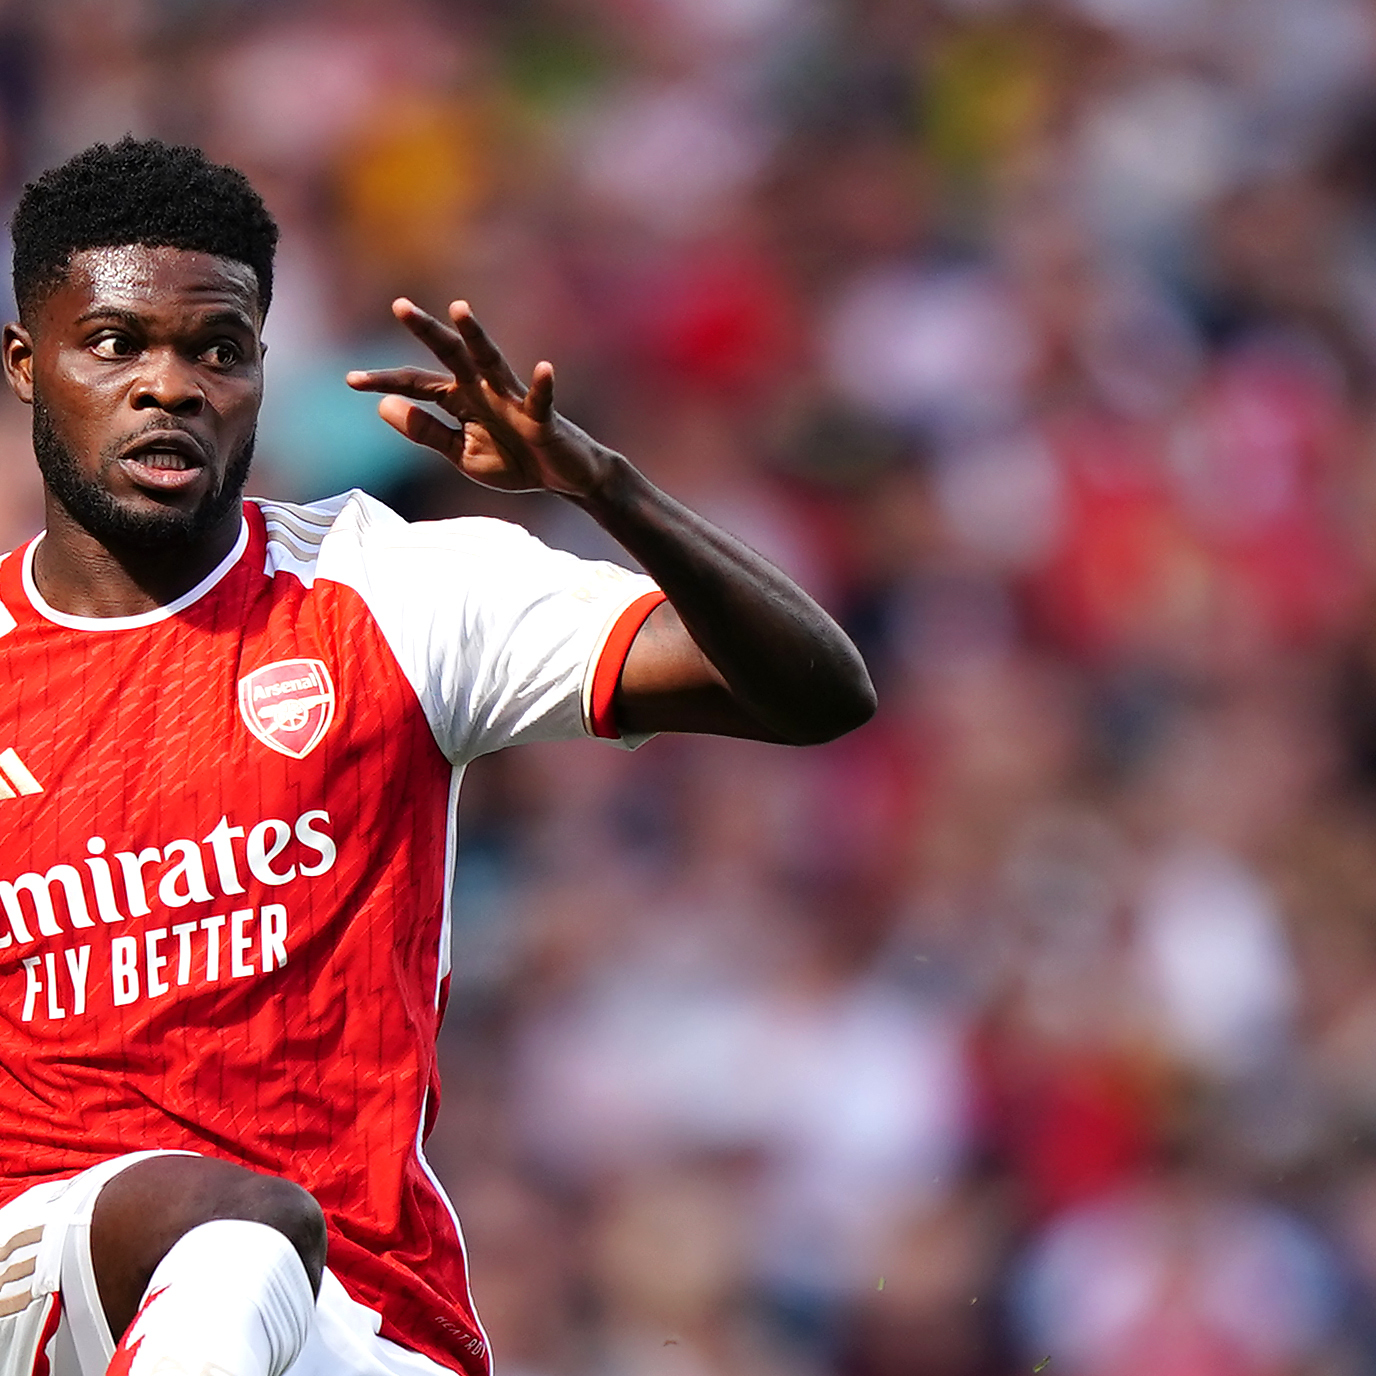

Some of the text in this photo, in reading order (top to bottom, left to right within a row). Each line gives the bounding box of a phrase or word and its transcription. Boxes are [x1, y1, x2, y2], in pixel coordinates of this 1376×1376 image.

[252, 672, 318, 702] Arsenal
[22, 903, 288, 1022] FLY BETTER
